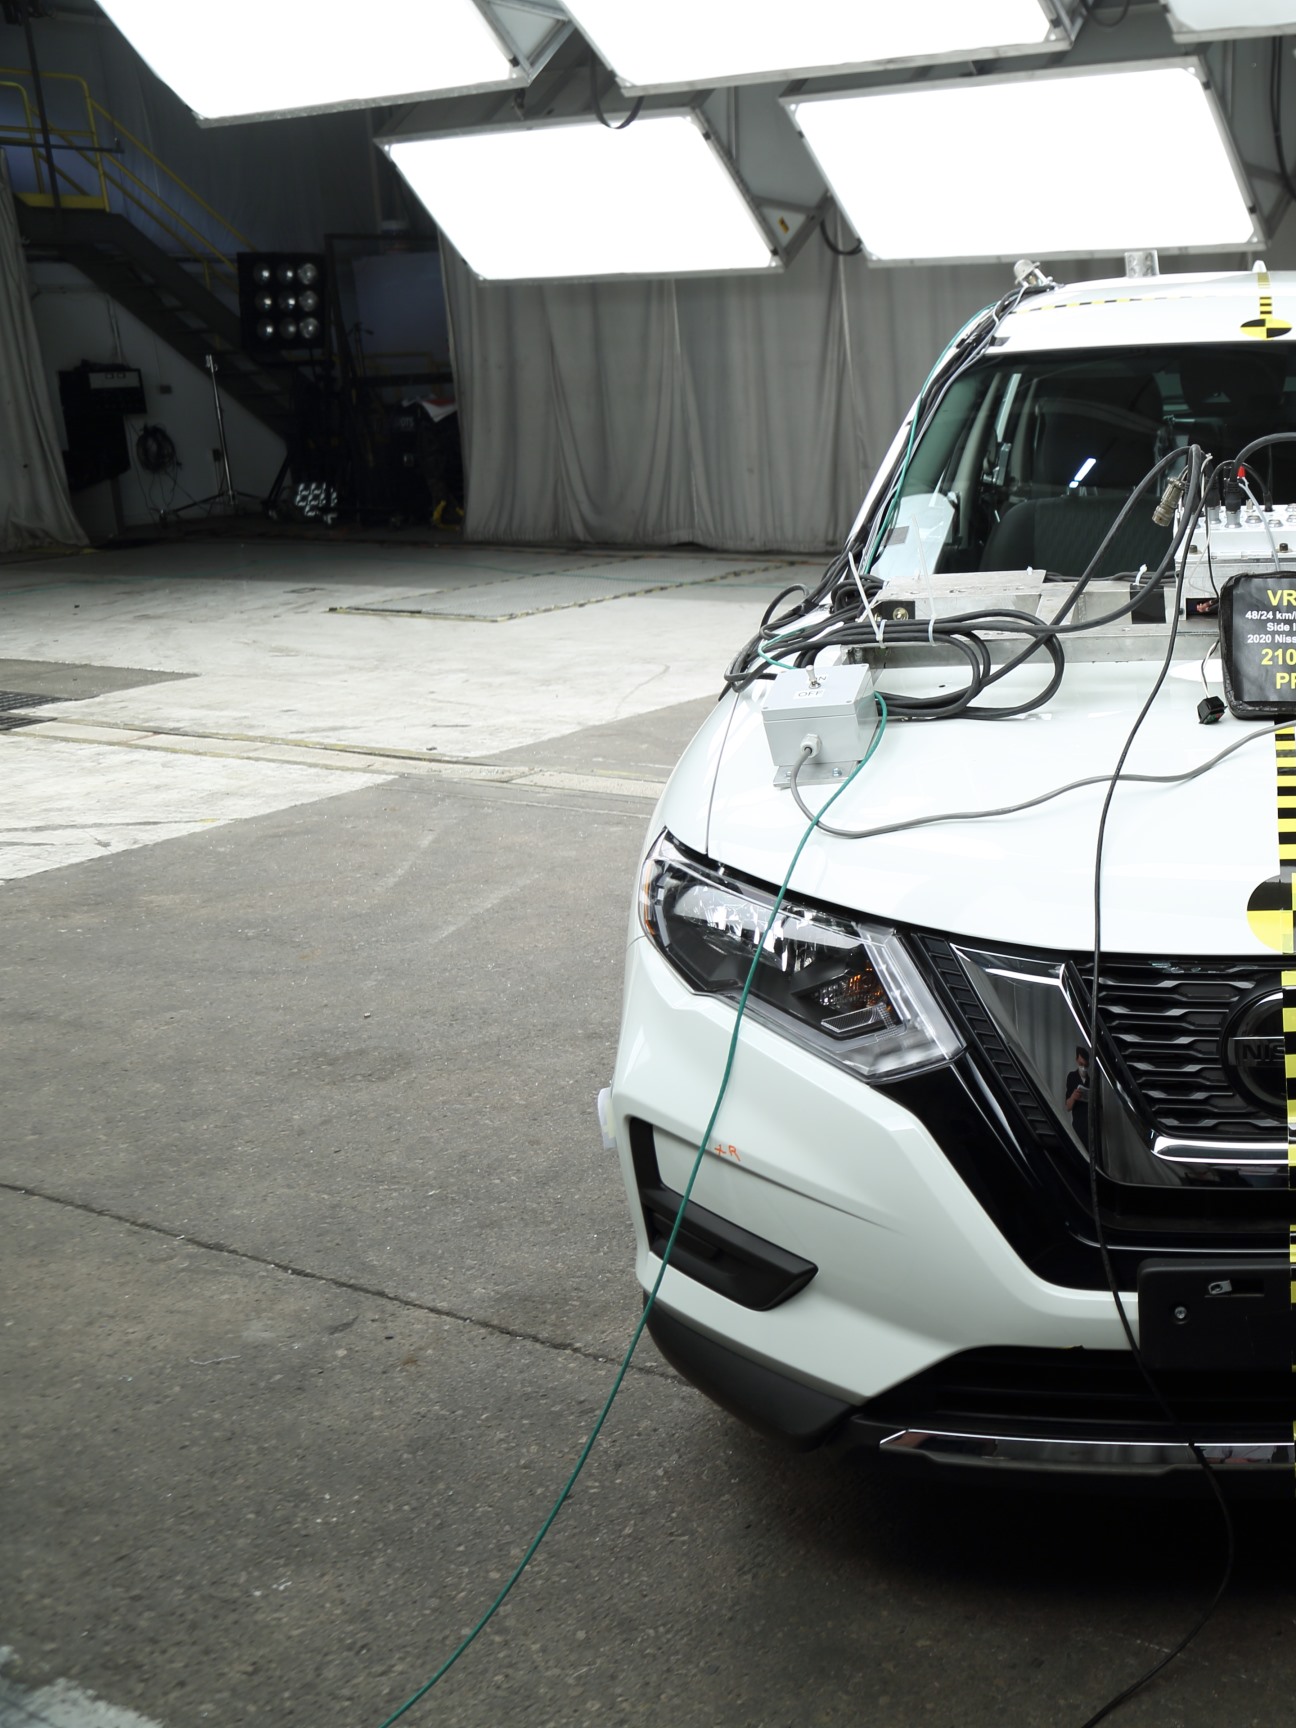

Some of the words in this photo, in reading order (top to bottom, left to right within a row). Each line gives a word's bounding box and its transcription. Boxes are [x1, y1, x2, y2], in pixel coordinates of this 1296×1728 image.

[1245, 611, 1273, 620] 48/24
[1266, 623, 1291, 632] Side
[1247, 634, 1272, 643] 2020
